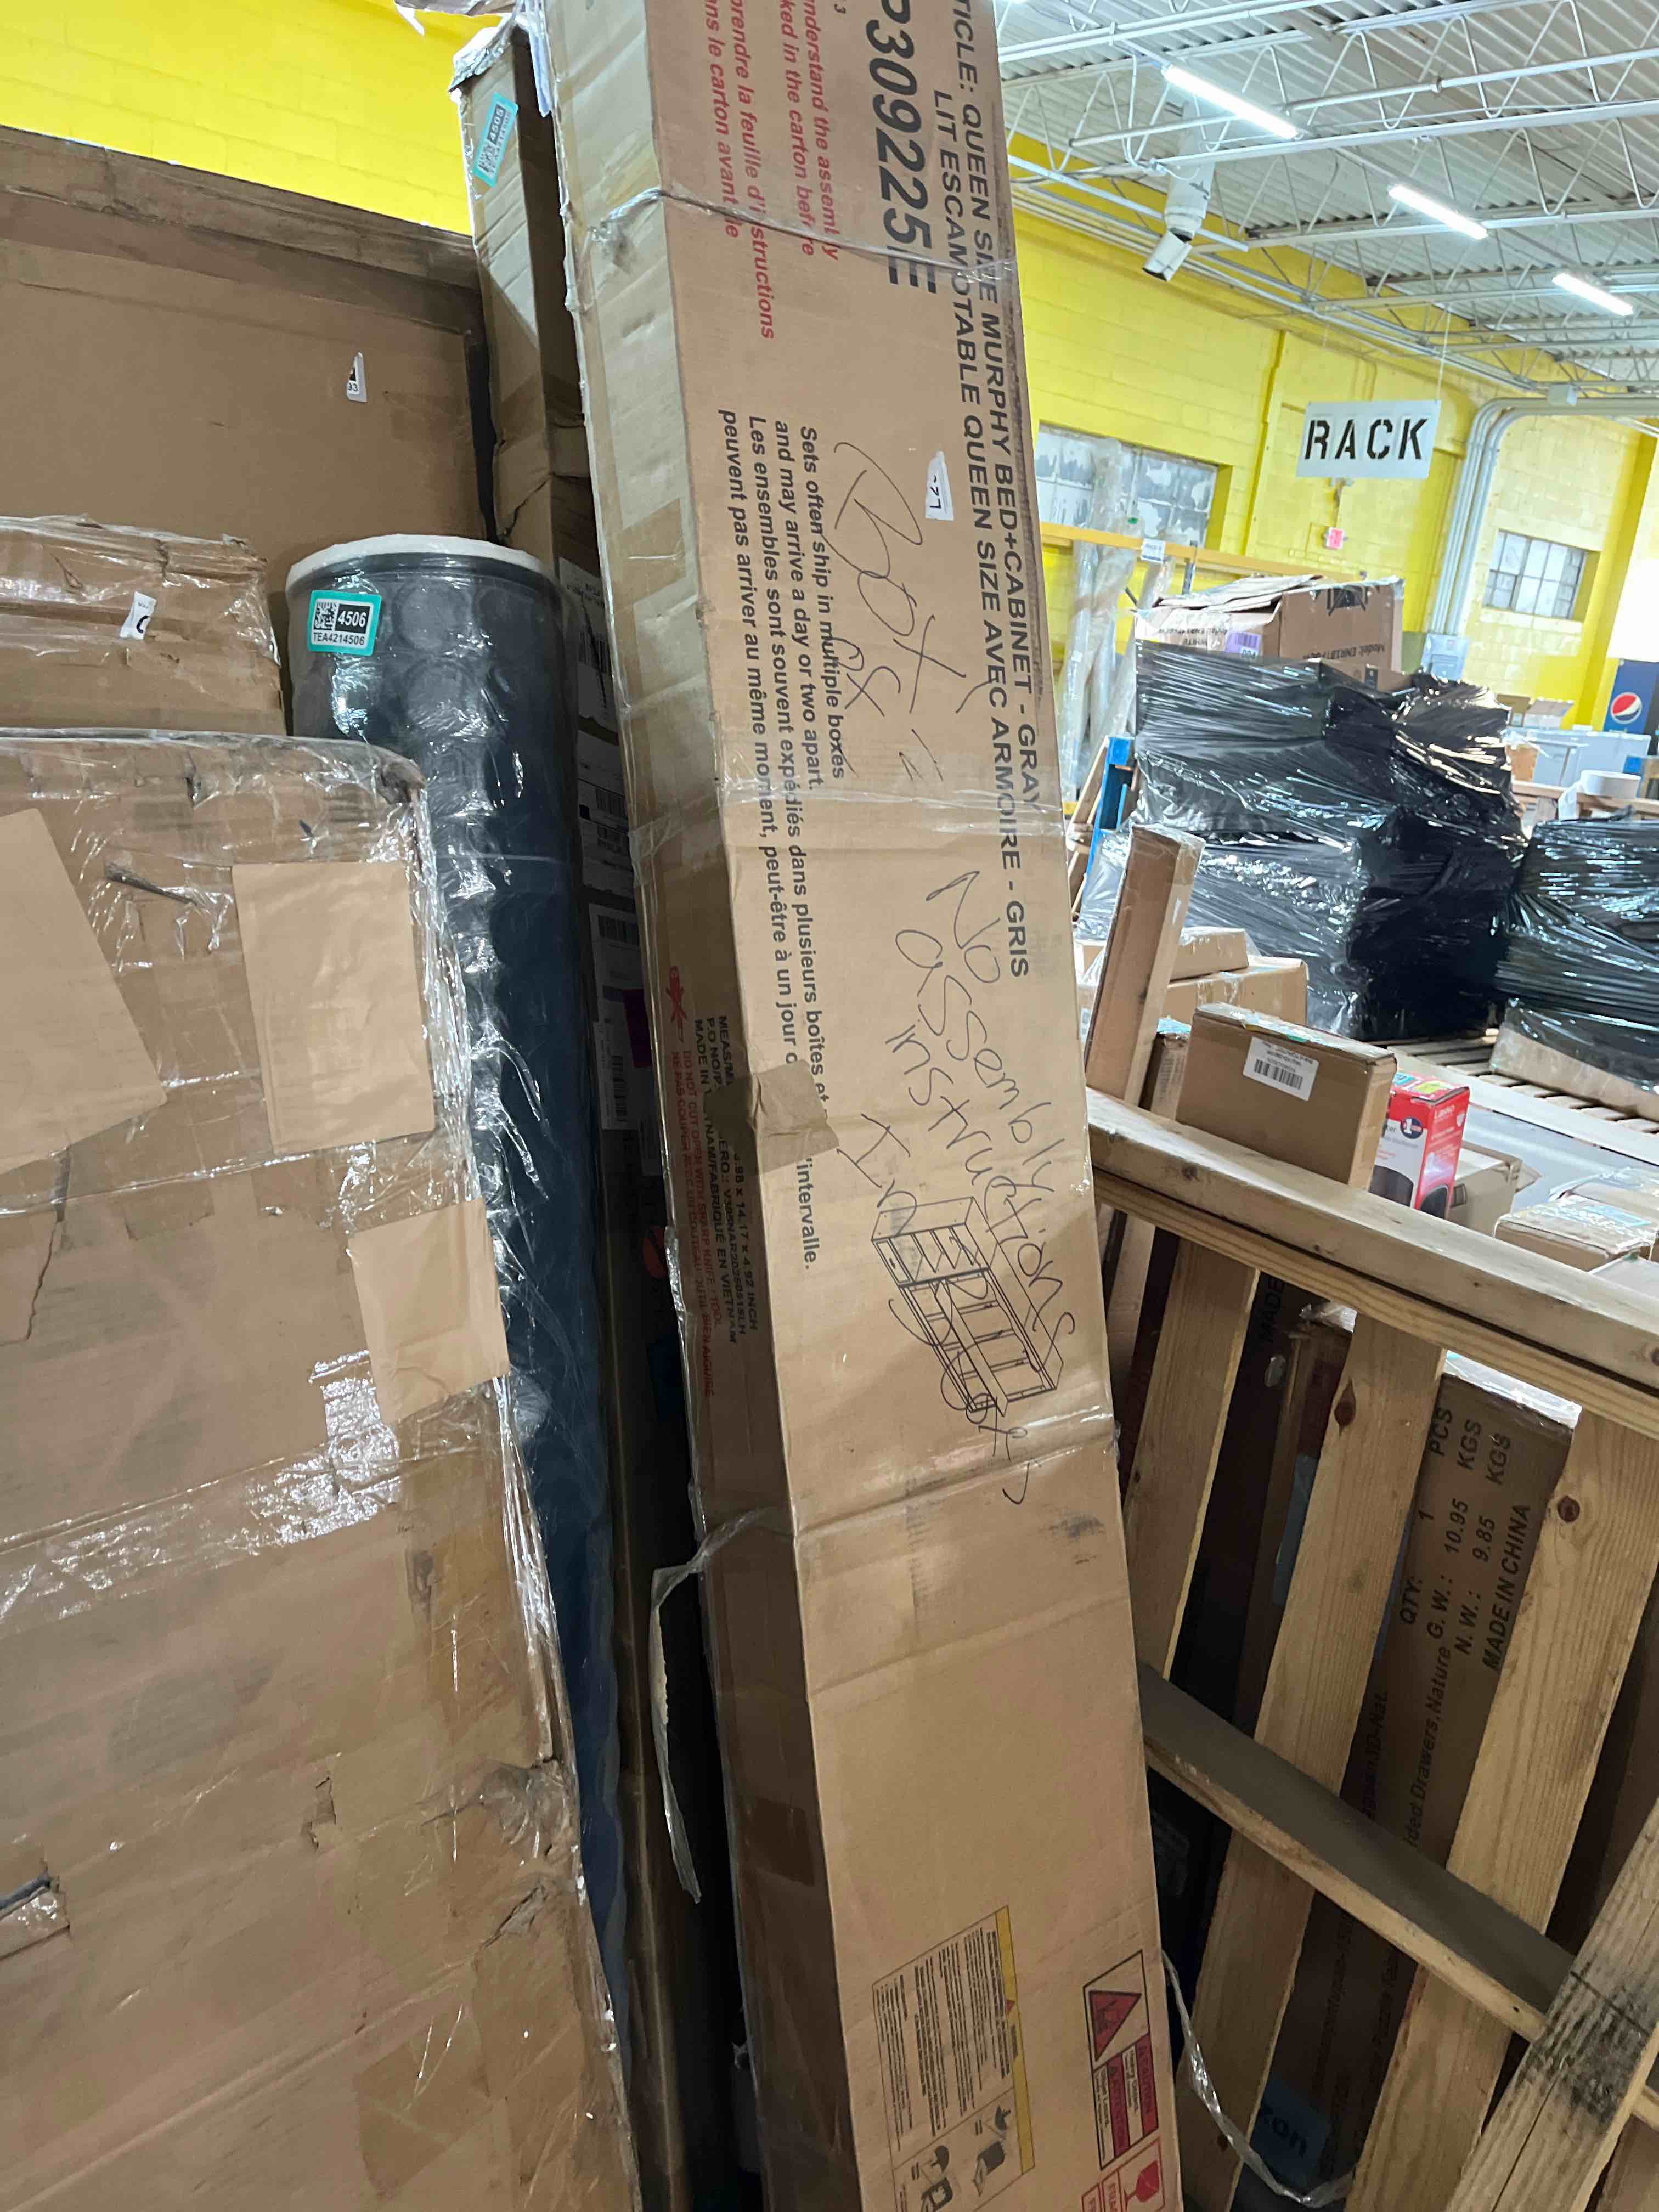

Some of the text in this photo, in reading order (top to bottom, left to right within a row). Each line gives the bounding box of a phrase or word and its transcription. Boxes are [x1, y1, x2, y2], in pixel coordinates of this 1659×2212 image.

[707, 37, 726, 58] le
[783, 42, 800, 63] in
[709, 64, 730, 136] carton
[737, 84, 755, 105] la
[785, 69, 802, 104] the
[813, 116, 830, 150] the
[933, 89, 957, 142] LIT
[788, 110, 808, 179] carton
[716, 141, 740, 205] avant
[939, 149, 980, 404] ESCAMOTABLE
[718, 409, 748, 500] peuvent
[748, 415, 767, 455] Les
[963, 104, 990, 221] QUEEN
[981, 312, 1011, 456] MURPHY
[996, 464, 1034, 694] BED+CABINET
[1018, 723, 1043, 813] GRAY
[1304, 417, 1429, 461] RACK
[963, 415, 992, 531] QUEEN
[727, 506, 750, 546] pas
[753, 461, 780, 581] ensembles
[736, 553, 758, 628] arriver
[800, 425, 846, 779] Sets often ship in multiple boxes
[975, 541, 1000, 613] SIZE
[337, 610, 367, 628] 4506
[766, 588, 787, 637] sont
[774, 420, 824, 791] and may arrive a day or two apart.
[313, 631, 365, 646] TEA4214506
[744, 633, 761, 660] au
[771, 644, 795, 733] souvent
[983, 622, 1008, 709] AVEC
[747, 667, 768, 735] même
[778, 740, 803, 838] expédiés
[990, 718, 1021, 870] ARMOIRE
[758, 845, 789, 943] peut-être
[789, 844, 808, 896] dans
[789, 902, 819, 1003] plusieurs
[926, 871, 1000, 984] No
[1006, 900, 1029, 978] GRIS
[772, 949, 794, 962] à
[775, 969, 792, 996] un
[695, 1019, 708, 1065] MADE
[774, 1001, 796, 1045] jour
[805, 1010, 827, 1076] boîtes
[674, 1072, 685, 1096] PAS
[682, 1051, 692, 1068] DO
[686, 1072, 697, 1097] NOT
[700, 1069, 709, 1085] IN
[677, 1099, 691, 1150] COUPER
[689, 1102, 699, 1126] CUT
[691, 1131, 703, 1164] OPEN
[695, 1169, 704, 1198] WITH
[691, 1212, 701, 1272] COUTEAU
[697, 1201, 709, 1245] SHARP
[703, 1249, 714, 1282] KNIFE
[716, 1249, 727, 1269] EN
[702, 1314, 713, 1344] BIEN
[721, 1274, 737, 1344] VIETNAM
[747, 1292, 758, 1330] INCH
[702, 1346, 716, 1396] AIGUISÉ
[1444, 1498, 1468, 1554] 10.95
[1457, 1419, 1482, 1470] KGS
[1472, 1515, 1495, 1564] 9.85
[1485, 1432, 1510, 1486] KGS
[1400, 1407, 1453, 1625] QTY: 1 PCS
[1482, 1504, 1531, 1672] MADE IN CHINA
